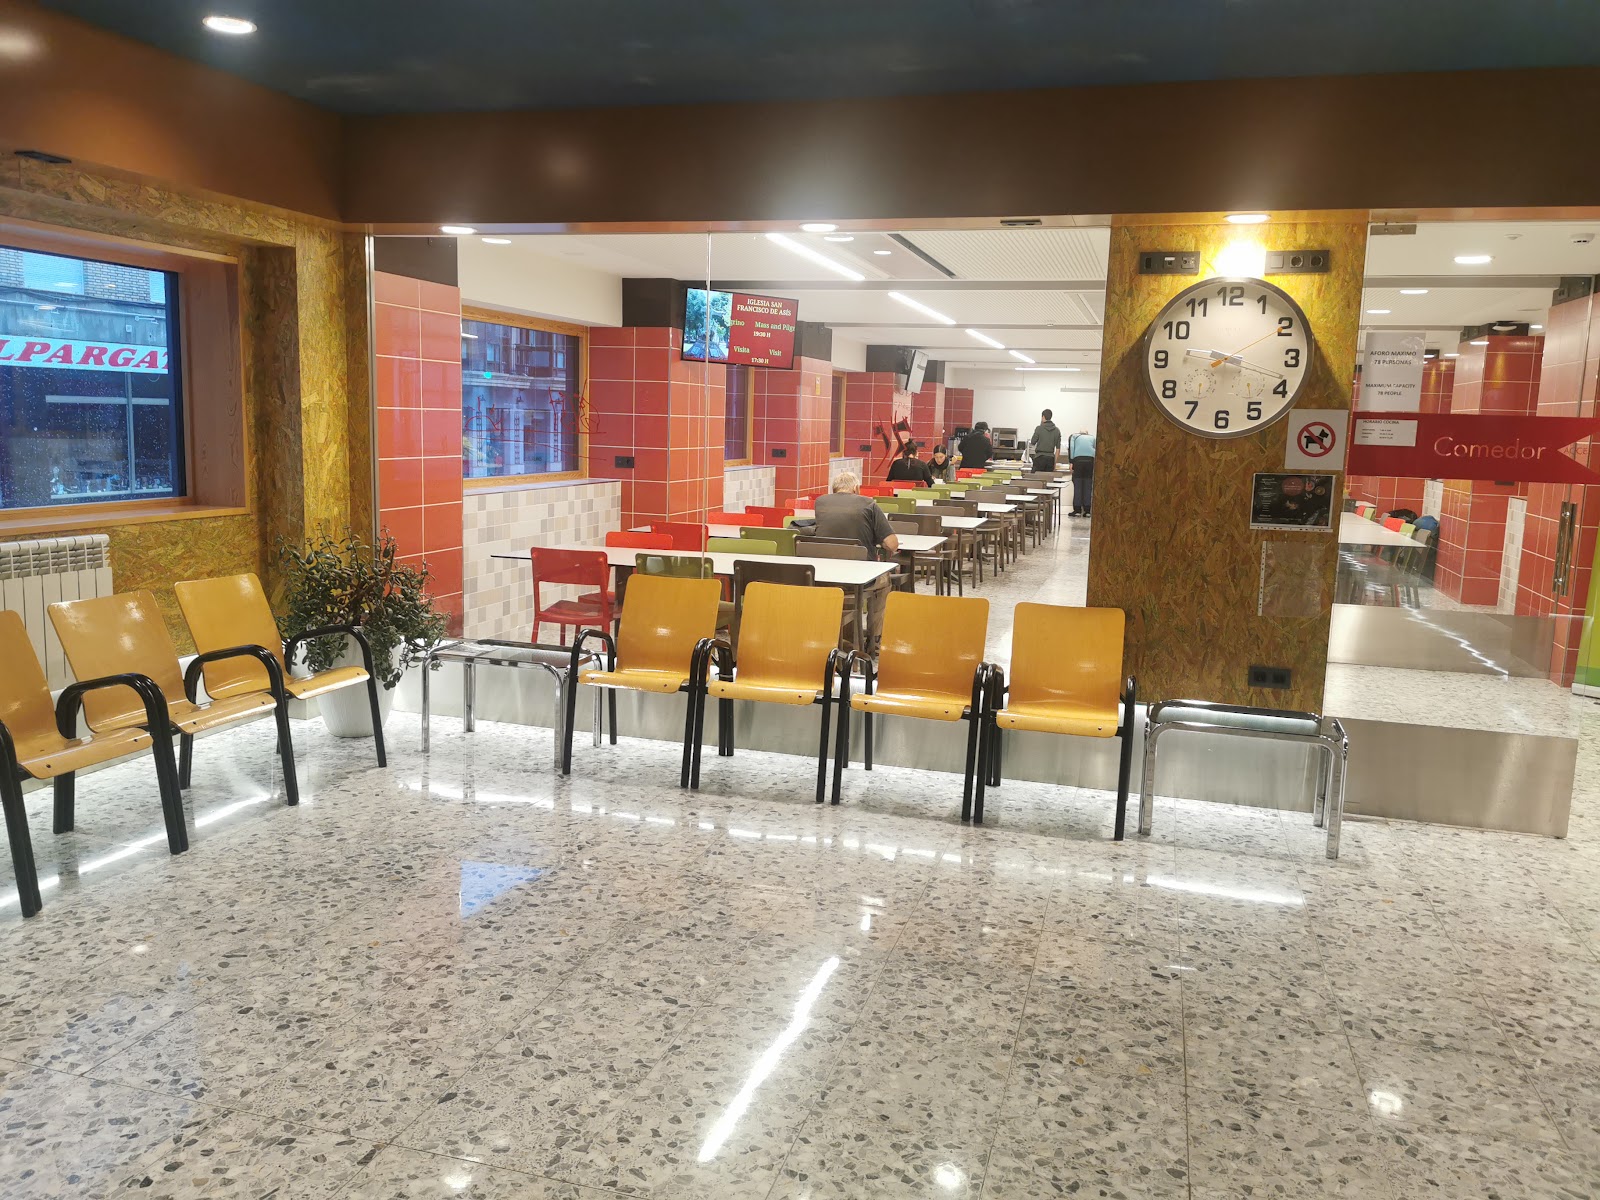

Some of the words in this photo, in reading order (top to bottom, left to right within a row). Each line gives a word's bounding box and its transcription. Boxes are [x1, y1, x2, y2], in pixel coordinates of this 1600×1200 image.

[747, 298, 770, 307] IGLESIA
[1216, 286, 1244, 306] 12
[1257, 295, 1267, 314] 1
[737, 304, 769, 314] FRANCISCO
[1186, 298, 1208, 317] 11
[1163, 321, 1190, 340] 10
[1278, 317, 1293, 336] 2
[0, 340, 168, 369] LPARGA
[1154, 350, 1168, 368] 9
[1284, 349, 1300, 368] 3
[1162, 380, 1176, 398] 8
[1273, 380, 1288, 398] 4
[1185, 401, 1198, 420] 7
[1214, 410, 1230, 429] 6
[1247, 402, 1262, 420] 5
[1434, 436, 1546, 459] Comedor
